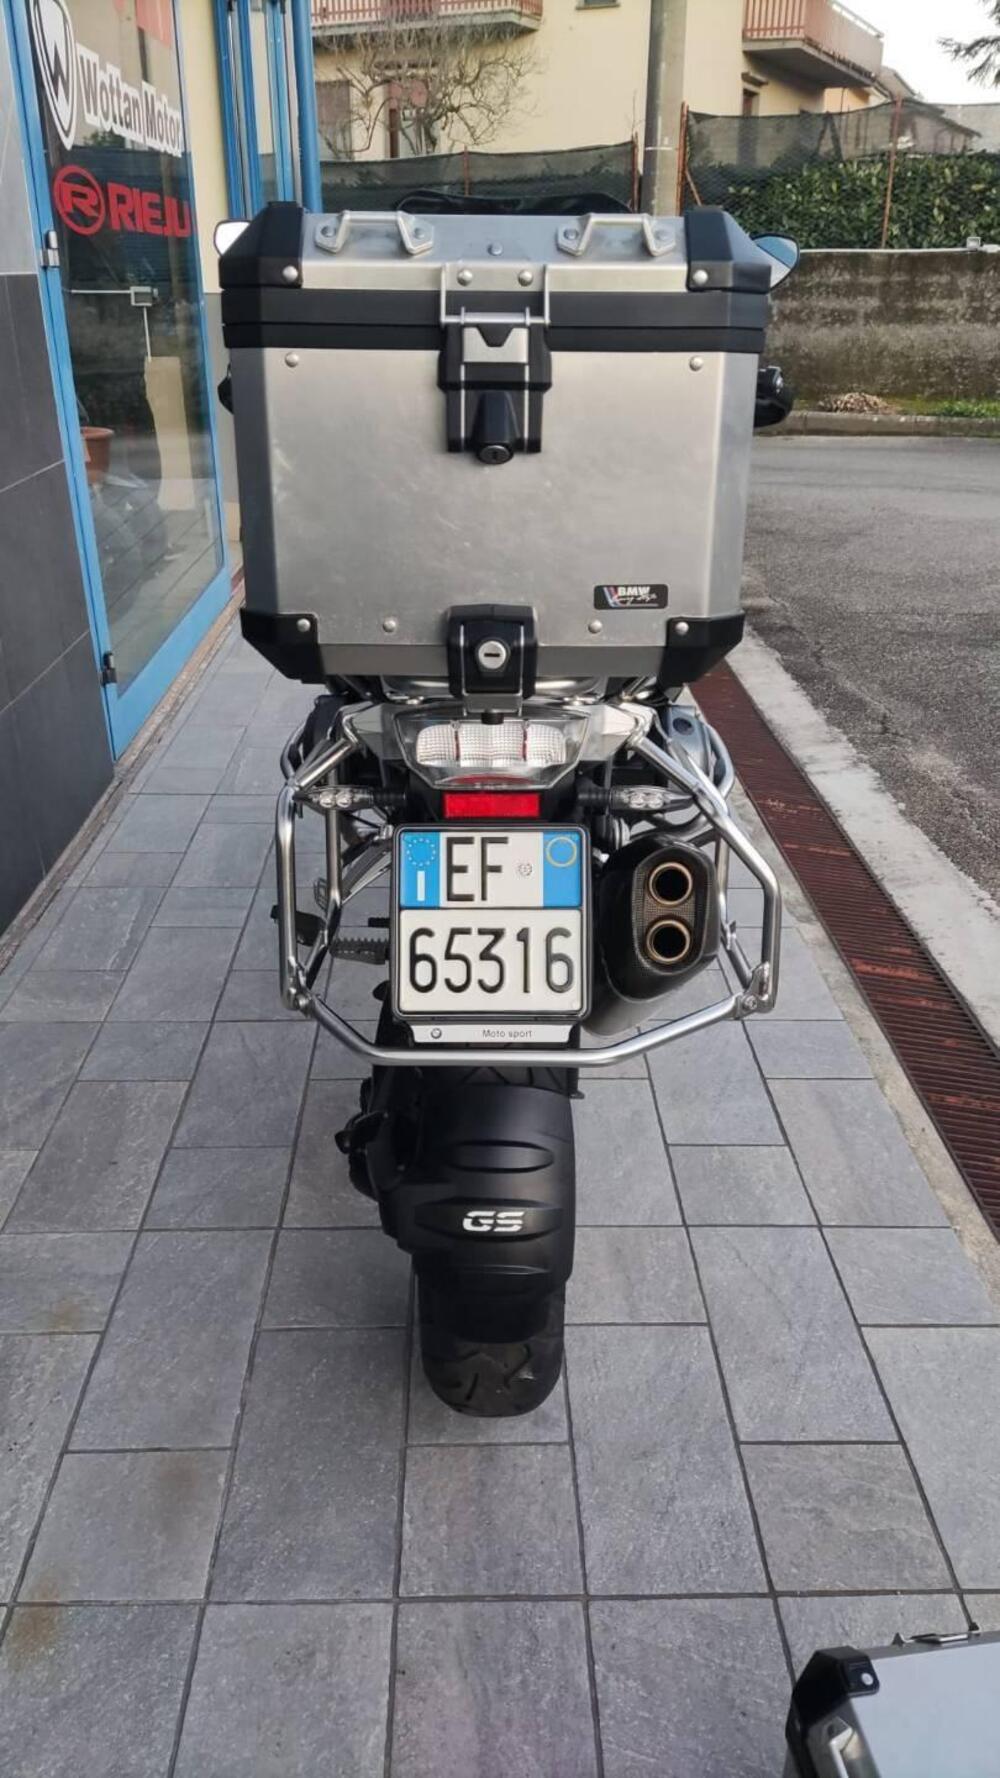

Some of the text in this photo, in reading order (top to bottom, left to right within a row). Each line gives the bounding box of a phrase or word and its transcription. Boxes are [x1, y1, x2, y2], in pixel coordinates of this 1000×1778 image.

[78, 51, 181, 153] Wottan Motor
[107, 182, 191, 238] RIEJU
[617, 586, 650, 596] BMW
[446, 836, 508, 902] EF
[409, 926, 574, 994] 65316
[482, 1028, 533, 1040] Moto sport
[463, 1210, 525, 1232] GS
